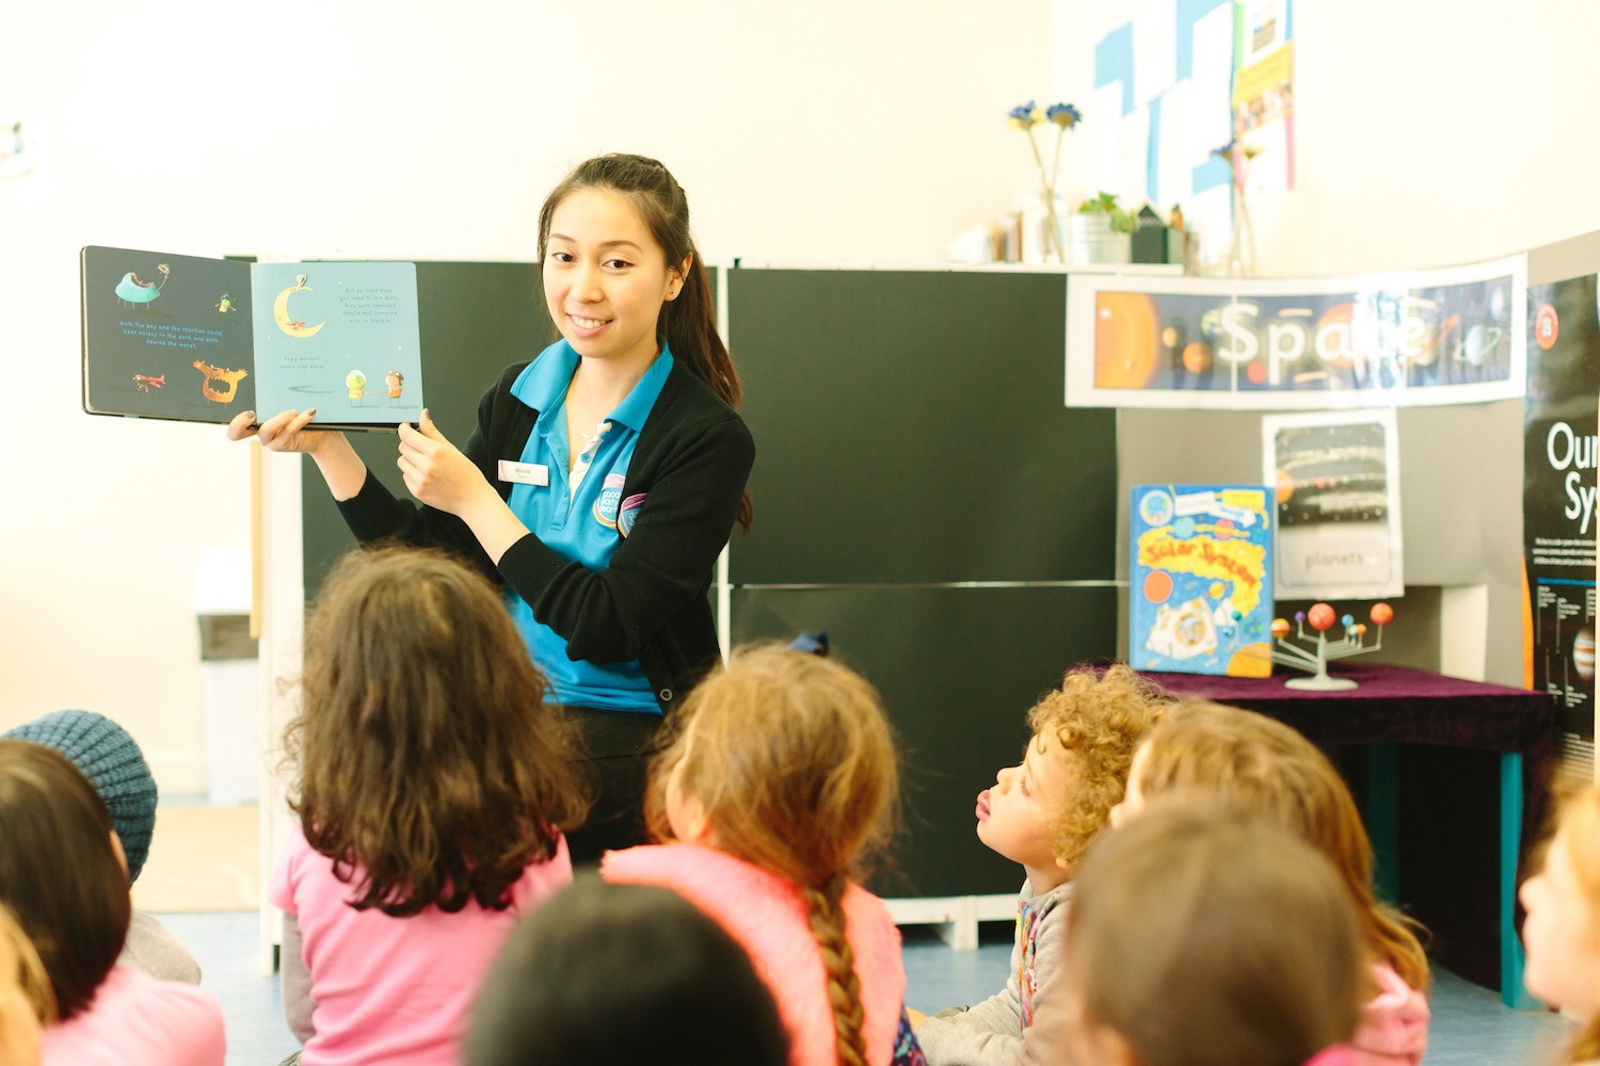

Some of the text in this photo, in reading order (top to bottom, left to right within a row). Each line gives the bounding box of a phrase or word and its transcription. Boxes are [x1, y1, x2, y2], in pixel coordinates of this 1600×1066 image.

[146, 323, 157, 331] boy
[206, 329, 222, 337] could
[146, 338, 166, 346] feared
[1218, 302, 1426, 386] Spae
[1564, 470, 1598, 535] Sy
[1146, 542, 1197, 565] Solar
[1304, 550, 1364, 572] planets
